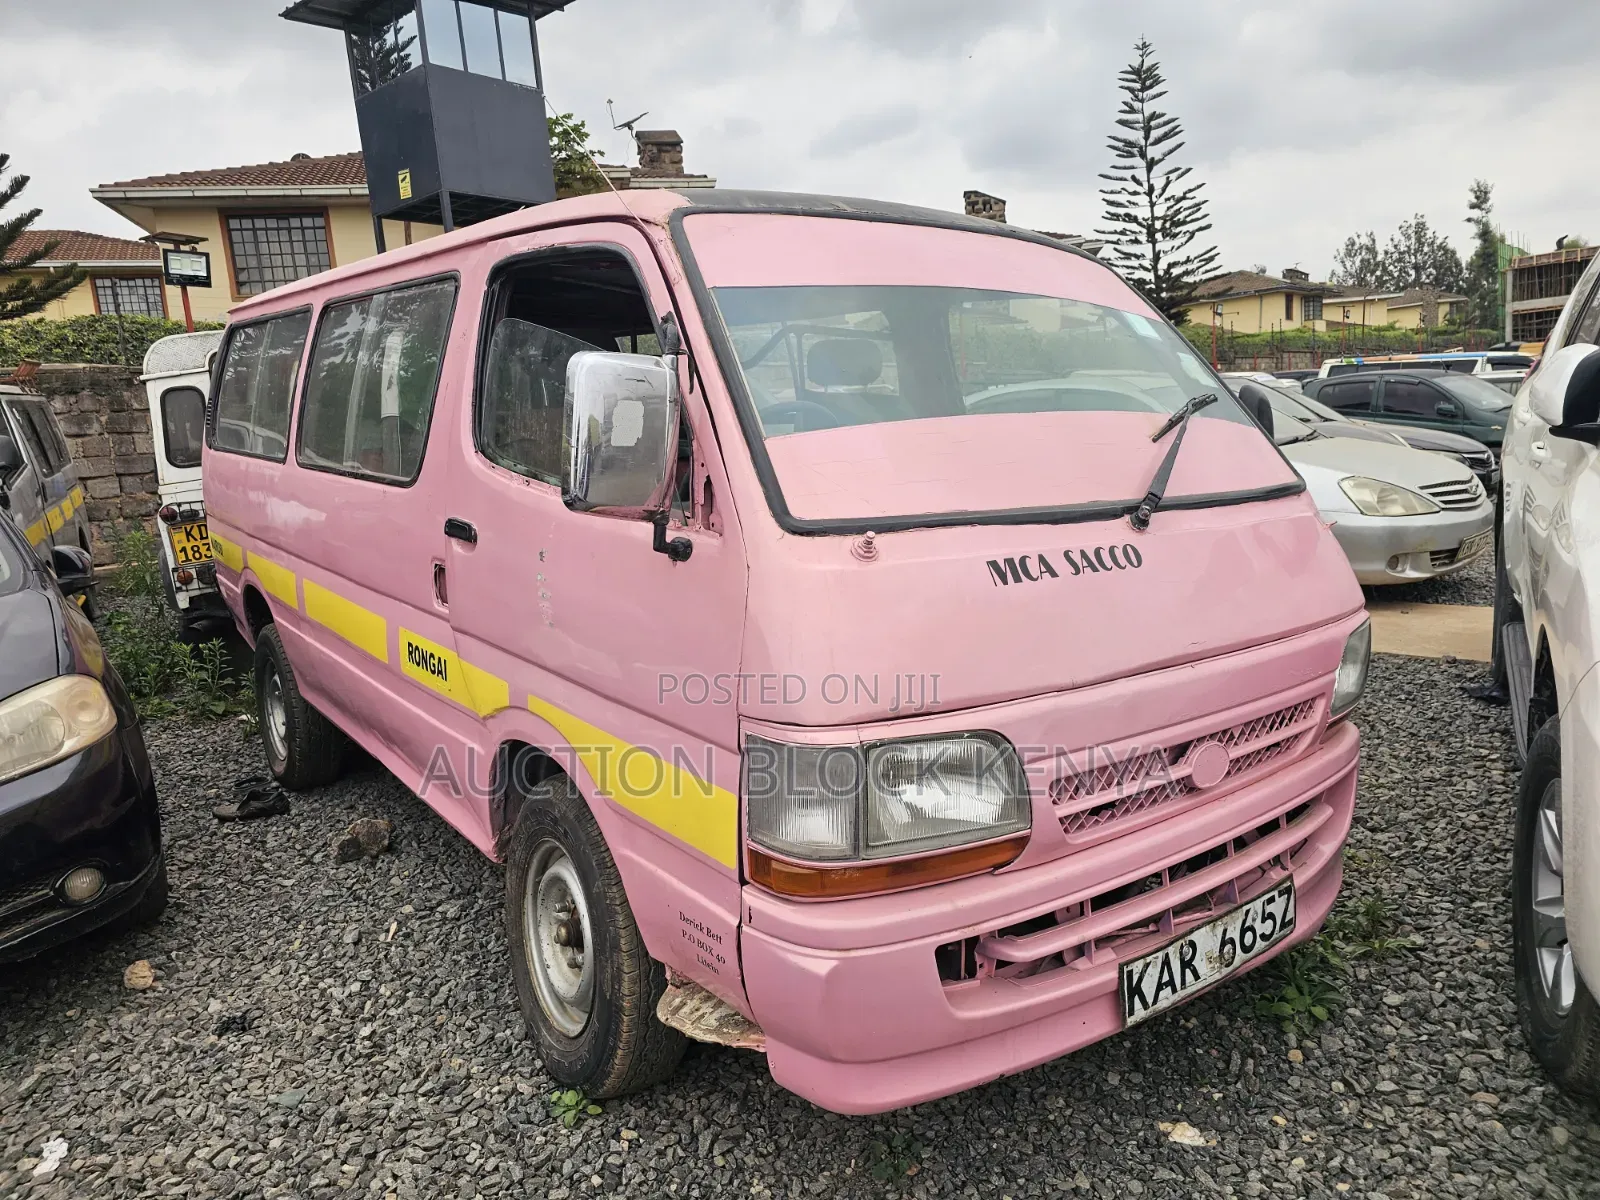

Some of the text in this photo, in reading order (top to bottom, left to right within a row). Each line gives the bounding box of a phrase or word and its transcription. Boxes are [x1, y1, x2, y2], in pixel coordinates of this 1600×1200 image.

[986, 543, 1143, 587] MCA SACCO
[407, 641, 448, 682] RONGAI
[679, 911, 723, 945] Derick Bett
[697, 938, 715, 957] BOX
[1125, 884, 1295, 1018] KAR 665Z
